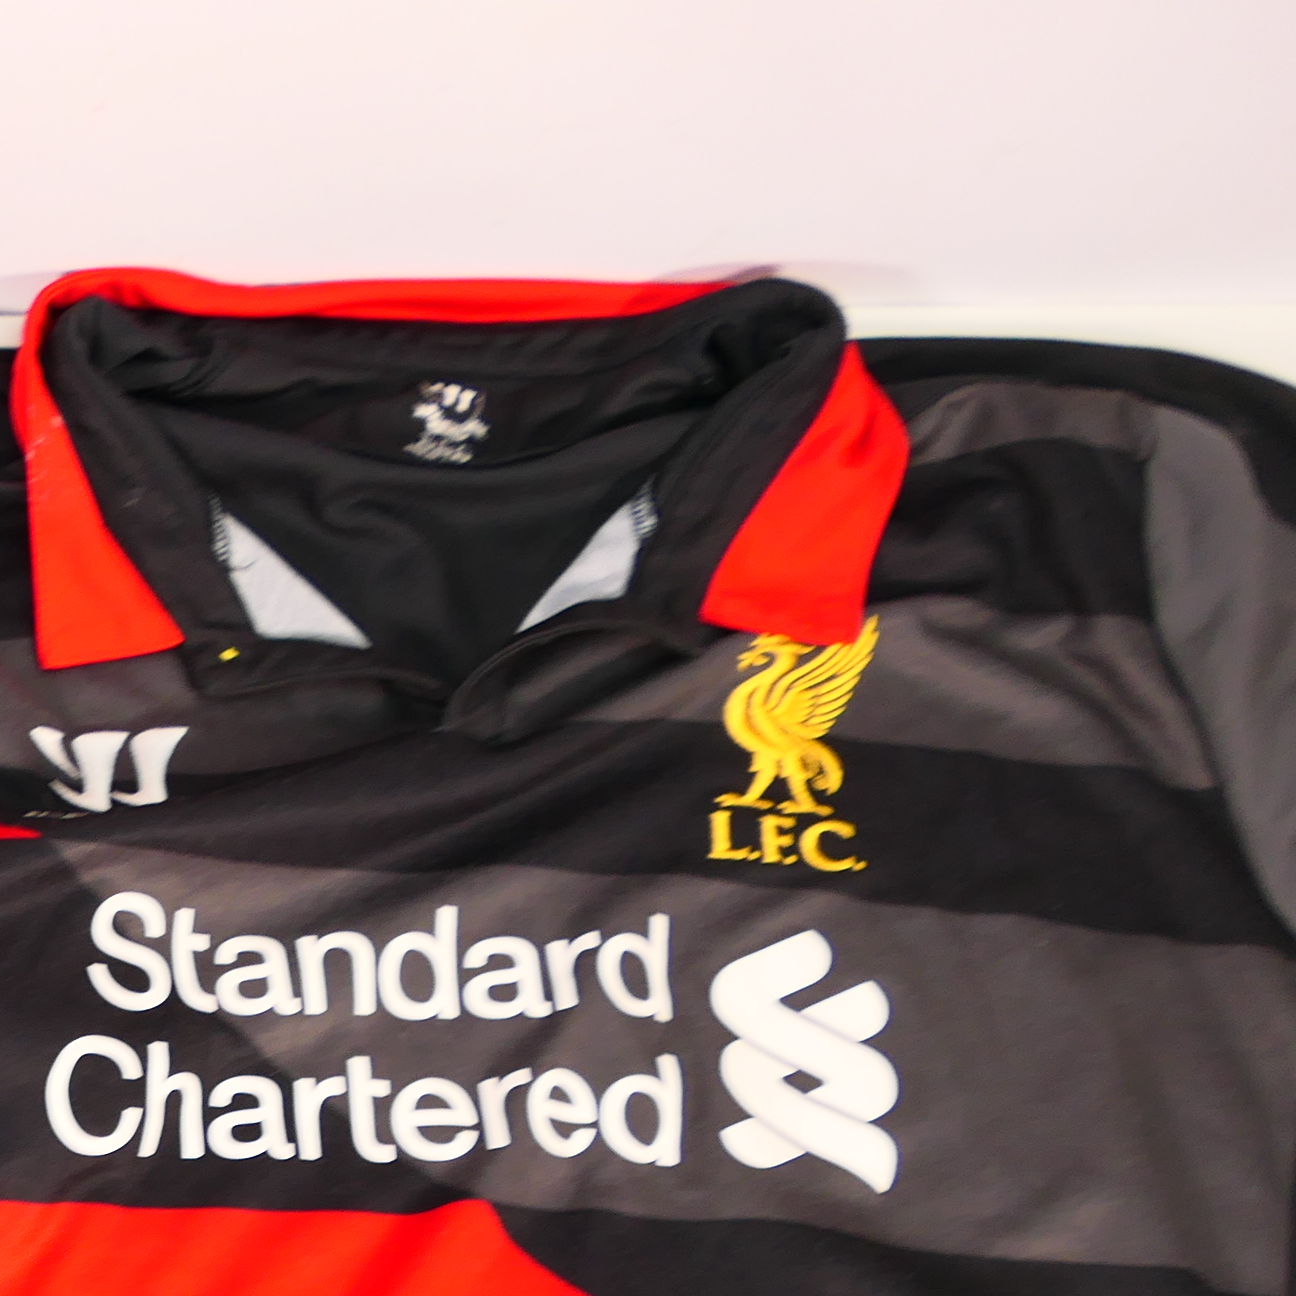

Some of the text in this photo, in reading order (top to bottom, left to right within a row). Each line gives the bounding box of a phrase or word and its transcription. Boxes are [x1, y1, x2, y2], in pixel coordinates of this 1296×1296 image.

[706, 809, 868, 872] L.F.C.
[86, 890, 674, 1024] Standard
[43, 1033, 683, 1168] Chartered
